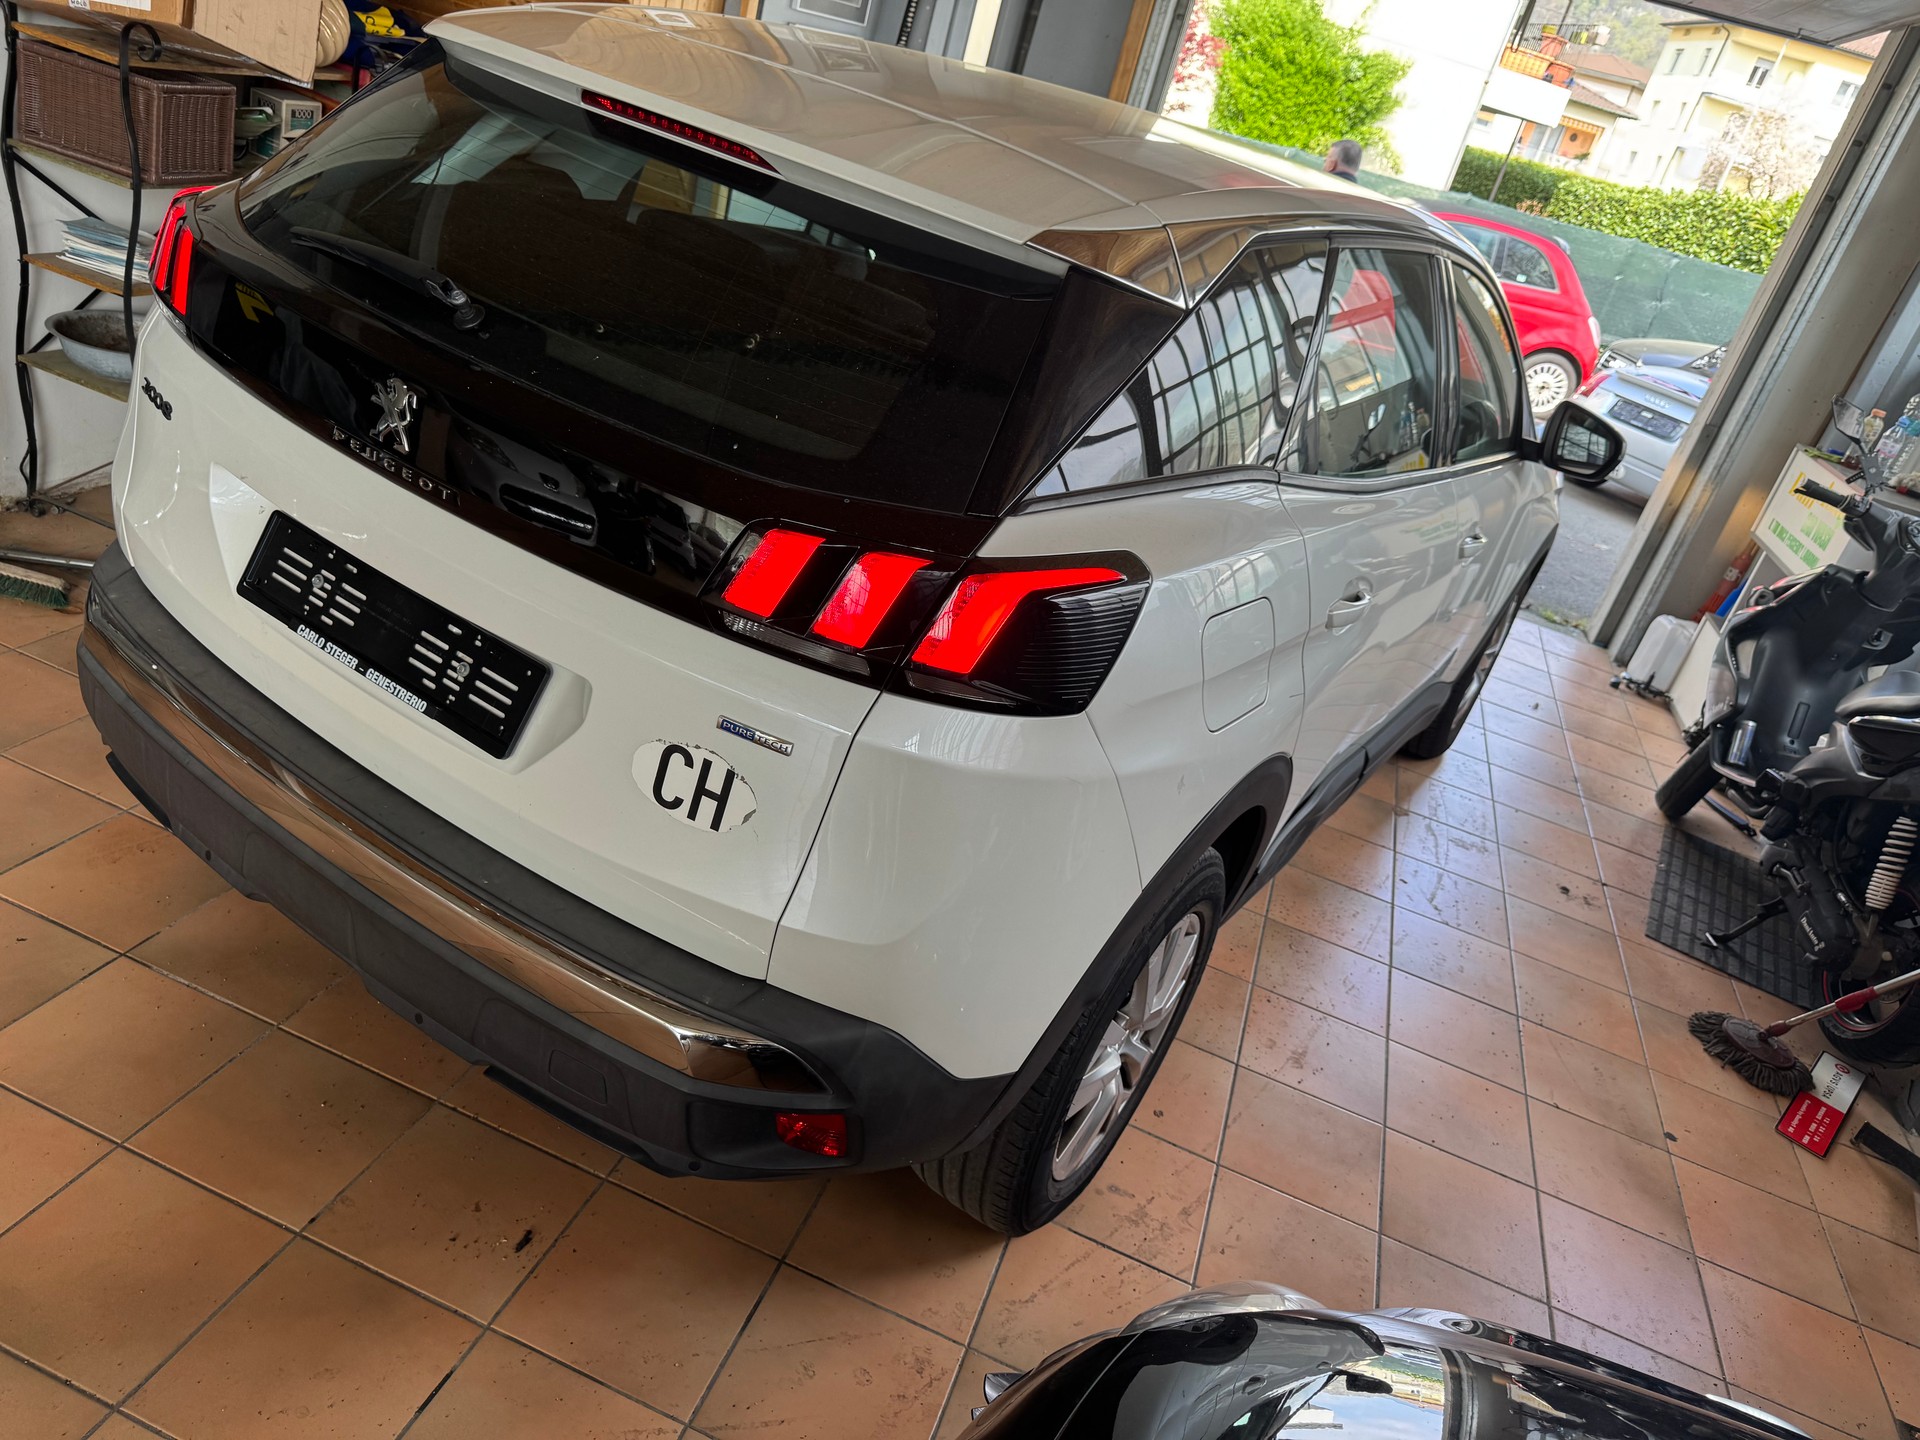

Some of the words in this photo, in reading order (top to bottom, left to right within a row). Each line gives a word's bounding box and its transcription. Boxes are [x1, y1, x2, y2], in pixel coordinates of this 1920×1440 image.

[295, 109, 312, 119] 1000
[333, 426, 451, 500] PEUGEOT
[296, 624, 325, 648] CARLO
[324, 642, 359, 670] STEGER
[365, 668, 428, 713] GENESTRERIO
[653, 744, 736, 832] CH
